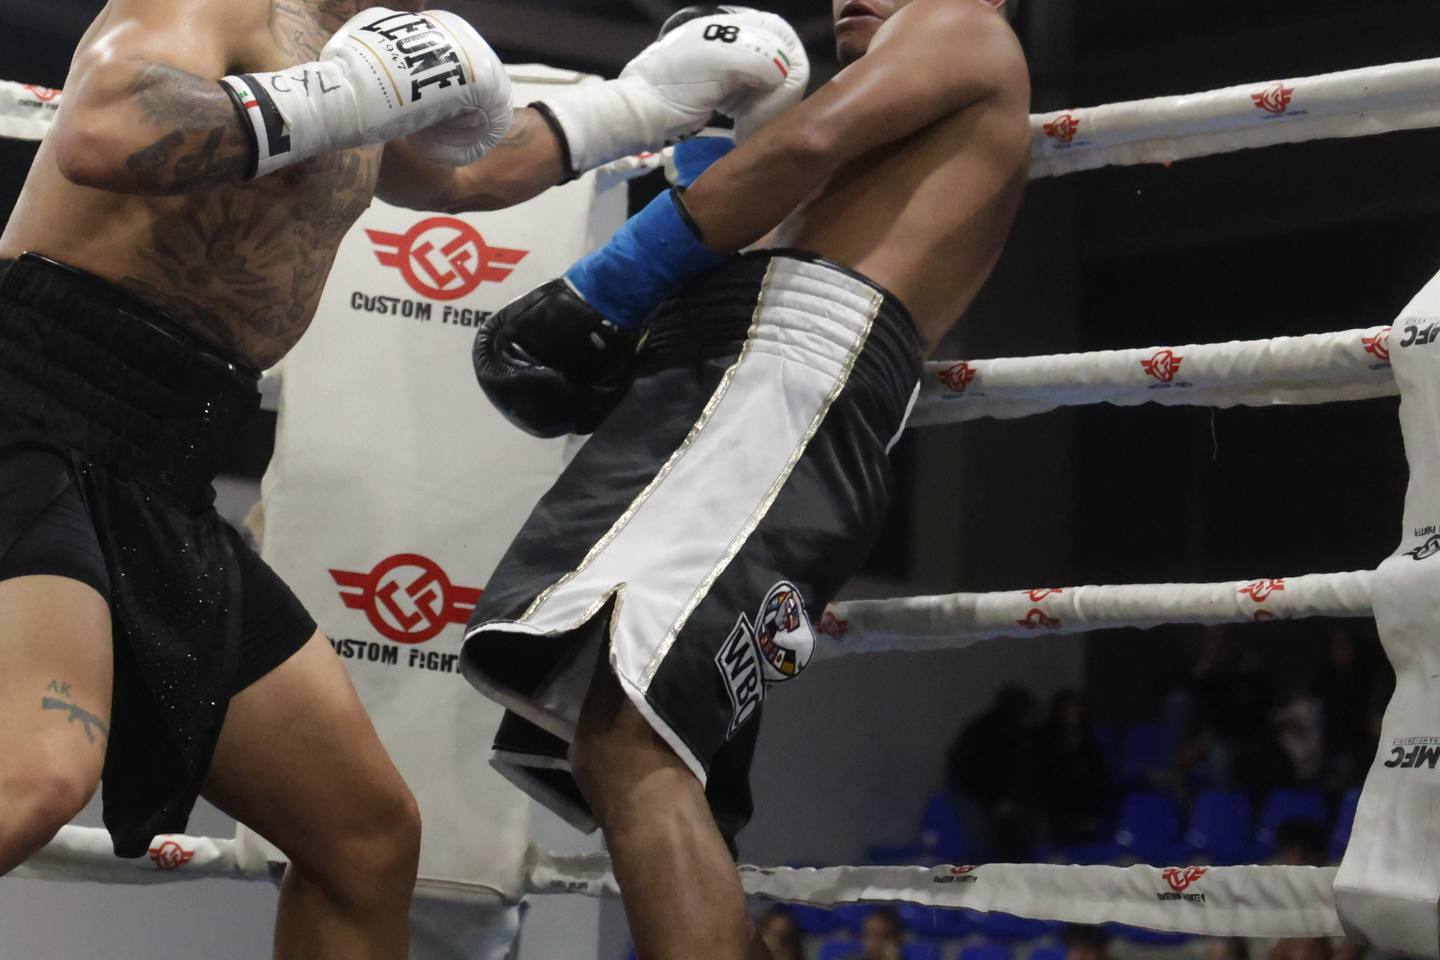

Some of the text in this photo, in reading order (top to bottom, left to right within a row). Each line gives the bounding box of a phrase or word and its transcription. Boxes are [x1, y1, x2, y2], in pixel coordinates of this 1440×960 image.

[360, 12, 466, 102] LEONE
[377, 38, 408, 70] 1947
[351, 291, 493, 328] CUSTOM FIGH
[1384, 745, 1440, 769] MFC
